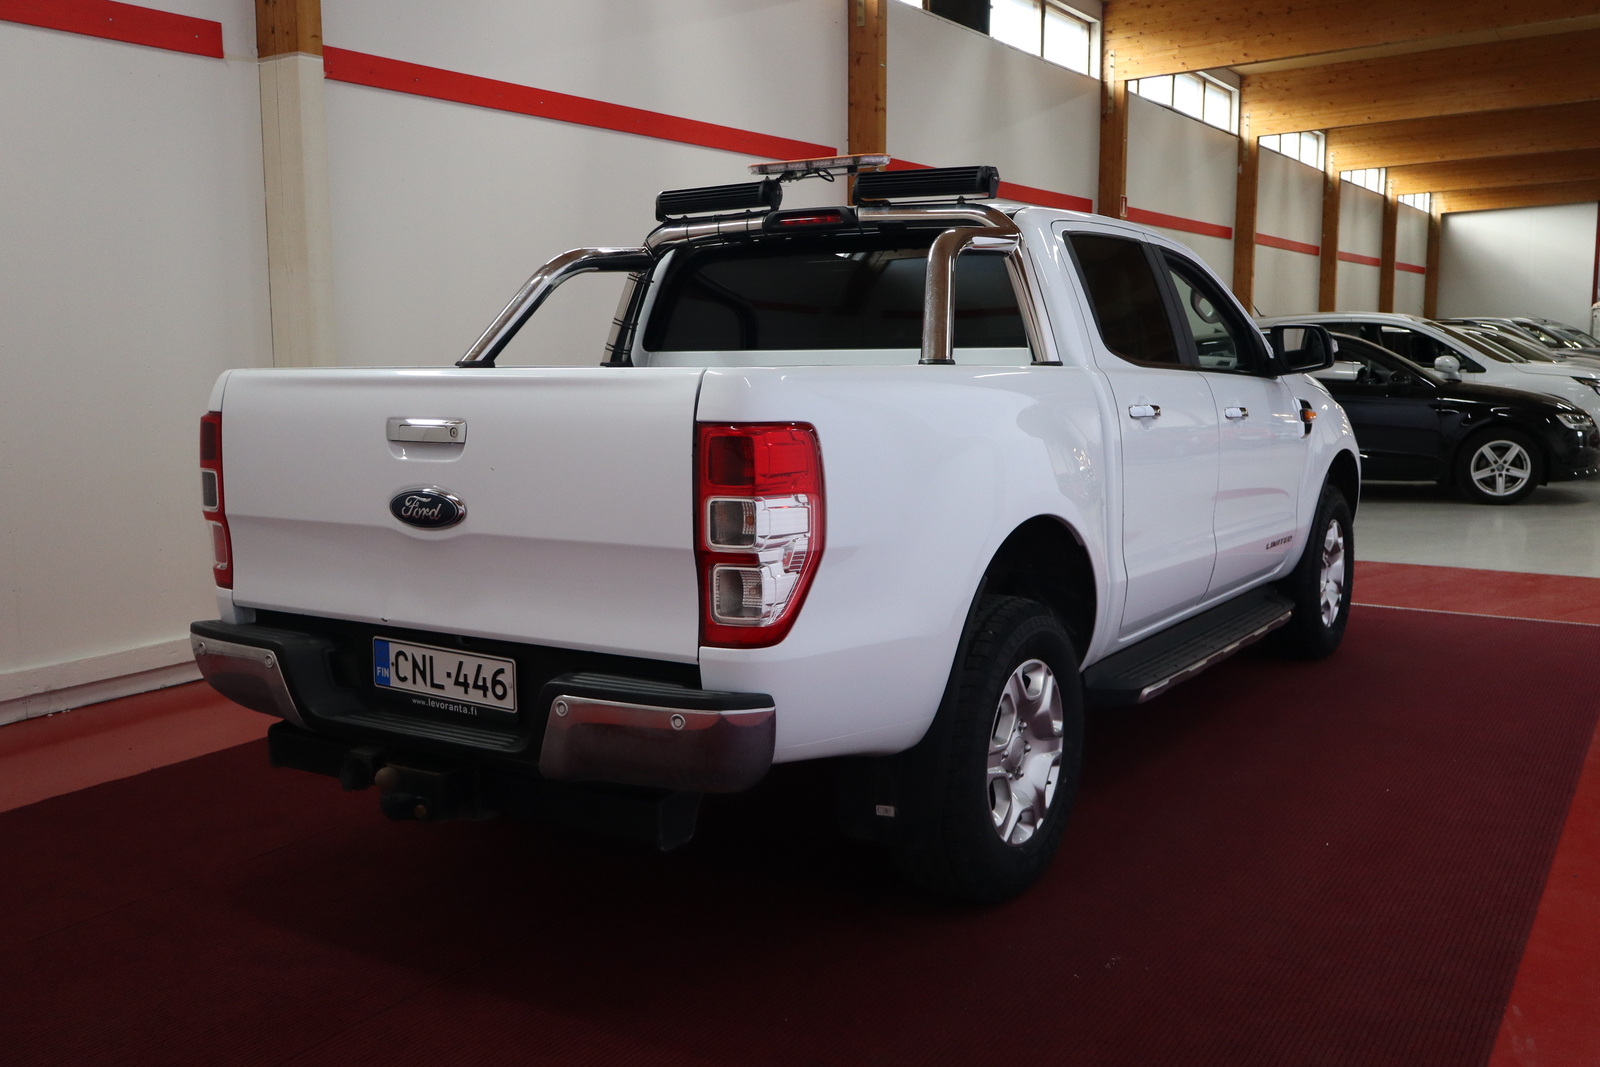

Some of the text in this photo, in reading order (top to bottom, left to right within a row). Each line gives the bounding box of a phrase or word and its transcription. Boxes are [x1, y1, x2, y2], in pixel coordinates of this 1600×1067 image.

[401, 495, 442, 520] Ford
[1265, 535, 1293, 550] LIMITED
[376, 666, 390, 678] FIN
[394, 649, 508, 701] CNL-446
[411, 697, 478, 716] www.levoranta.fi
